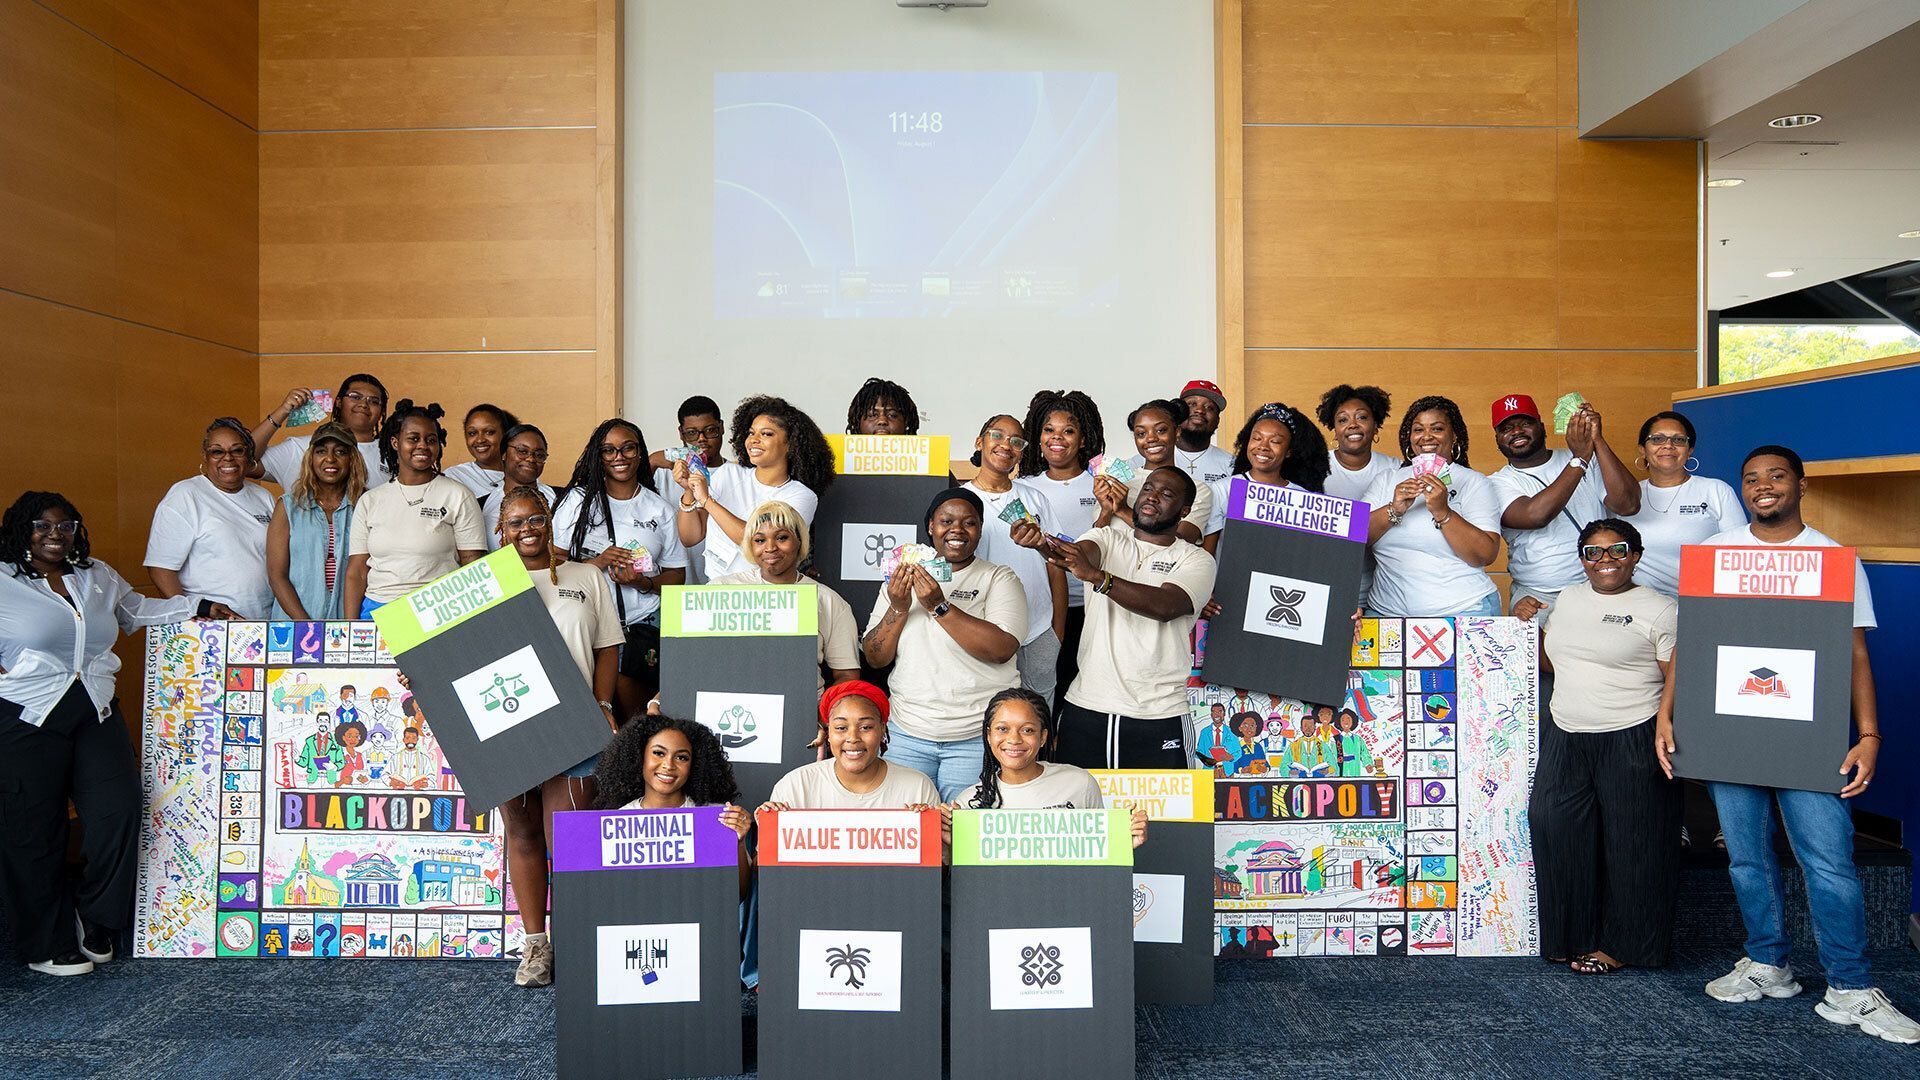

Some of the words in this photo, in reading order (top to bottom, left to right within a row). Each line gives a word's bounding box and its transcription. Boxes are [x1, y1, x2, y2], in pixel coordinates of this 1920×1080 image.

[888, 111, 943, 133] 11:48
[846, 437, 928, 455] COLLECTIVE
[853, 455, 918, 472] DECISION
[1248, 484, 1295, 507] SOCIAL
[1298, 497, 1352, 518] JUSTICE
[1256, 504, 1339, 534] CHALLENGE
[1720, 552, 1819, 572] EDUCATION
[411, 561, 492, 613] ECONOMIC
[1739, 574, 1799, 594] EQUITY
[434, 583, 494, 626] JUSTICE
[684, 590, 797, 611] ENVIRONMENT
[708, 612, 772, 632] JUSTICE
[199, 622, 224, 672] Love
[145, 669, 156, 730] DREAMVILLE
[1527, 665, 1536, 726] DREAMVILLE
[144, 733, 153, 759] YOUR
[1528, 728, 1536, 755] YOUR
[144, 762, 152, 772] IN
[1528, 757, 1536, 768] IN
[142, 775, 152, 820] HAPPENS
[1100, 776, 1191, 796] EALTHCARE
[229, 796, 243, 816] 336
[1215, 783, 1395, 819] ACKOPOLY
[602, 815, 692, 840] CRIMINAL
[982, 812, 1105, 835] GOVERNANCE
[142, 823, 150, 851] WHAT
[782, 828, 840, 850] VALUE
[846, 828, 918, 850] TOKENS
[981, 836, 1107, 859] OPPORTUNITY
[611, 840, 685, 865] JUSTICE
[1487, 842, 1500, 868] MATTER
[153, 886, 166, 911] VOTE
[1528, 905, 1537, 915] IN
[138, 906, 146, 916] IN
[1328, 915, 1352, 923] FUBU
[137, 919, 145, 954] DREAM
[1424, 917, 1442, 938] Legacy
[1529, 919, 1537, 955] DREAM
